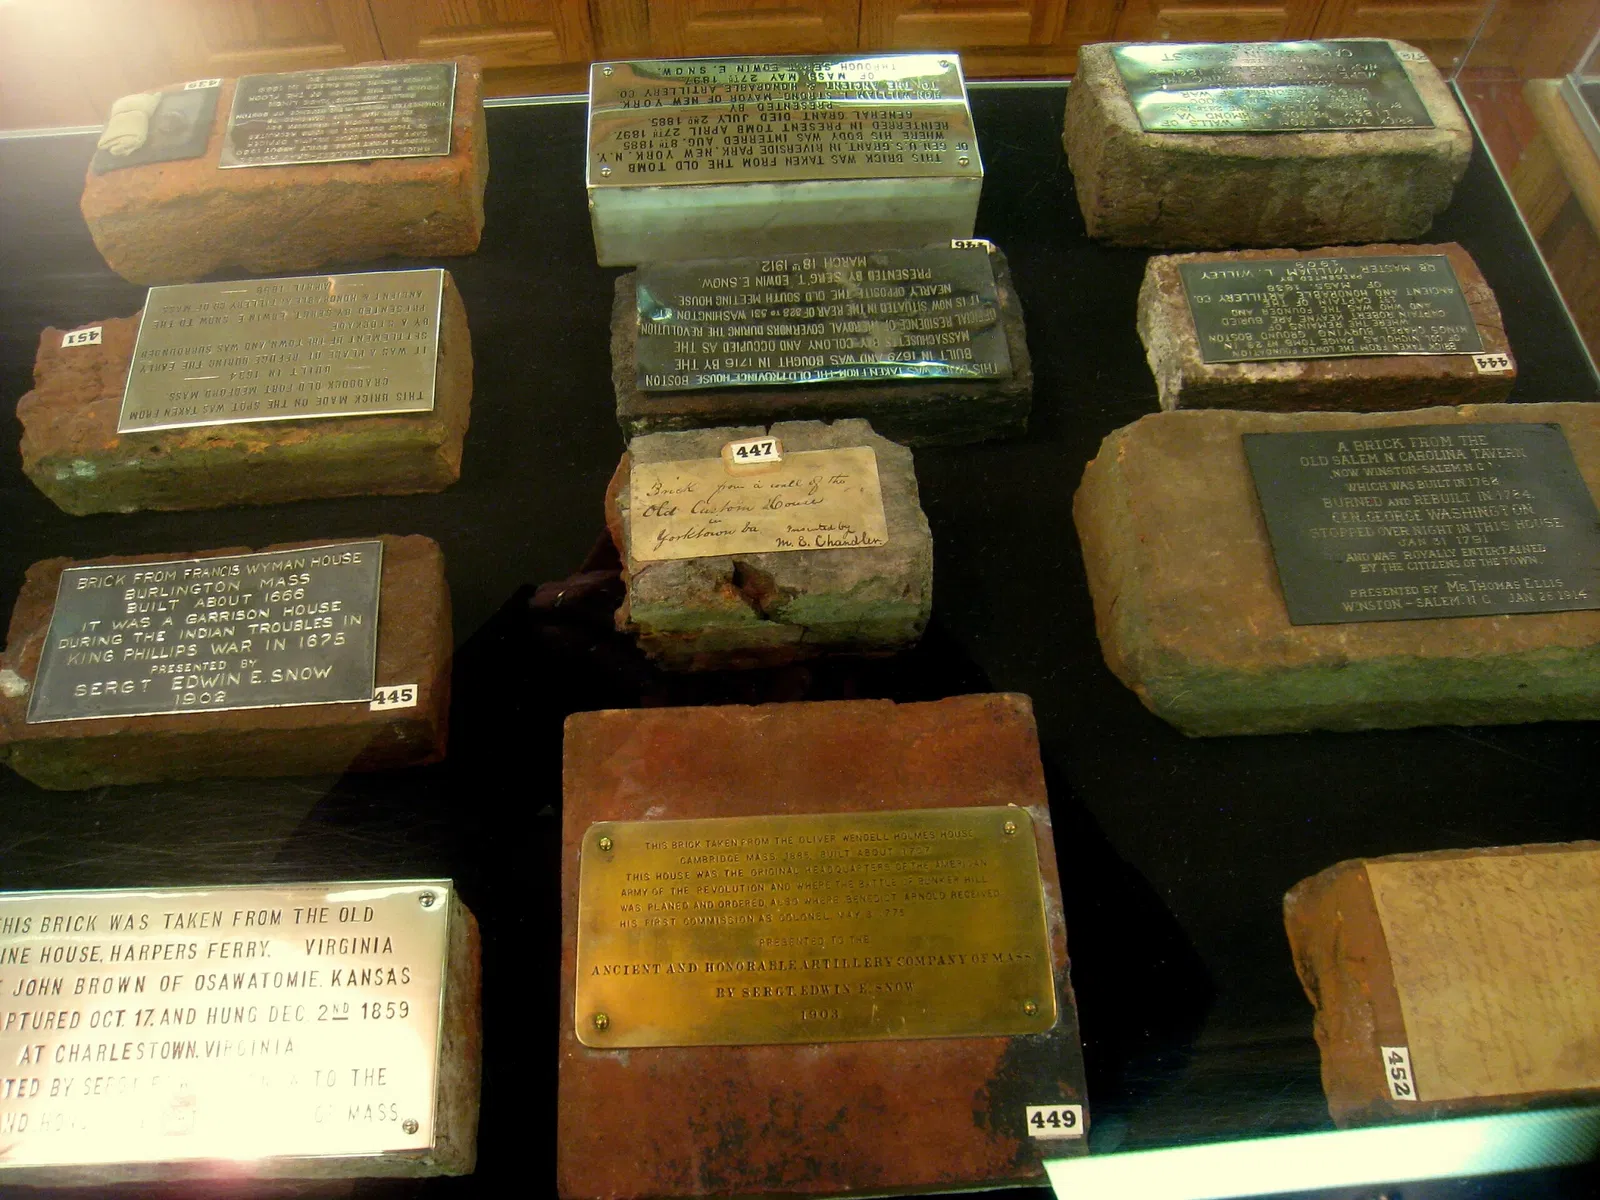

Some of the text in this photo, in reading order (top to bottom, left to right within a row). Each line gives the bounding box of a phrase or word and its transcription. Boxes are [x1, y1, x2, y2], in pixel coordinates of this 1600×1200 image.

[723, 133, 787, 144] INTERRED
[795, 132, 820, 141] WAS
[830, 131, 863, 141] BODY
[870, 131, 892, 141] HIS
[901, 130, 944, 141] WHERE
[622, 139, 653, 150] 1885
[627, 152, 942, 172] THIS BRICK WAS TAKEN FROM THE OLD TOMB
[754, 274, 789, 286] EDWIN
[847, 270, 863, 281] BY
[866, 267, 931, 281] PRESENTED
[1220, 309, 1446, 325] CAPTAIN ROBERT KEAYNE ARE BURIED
[68, 330, 99, 344] 451
[777, 354, 824, 367] BOUGHT
[829, 353, 855, 364] WAS
[859, 353, 883, 363] AND
[921, 350, 932, 360] IN
[939, 347, 972, 360] BUILT
[673, 357, 699, 371] THE
[702, 358, 720, 370] BY
[724, 356, 752, 367] 1716
[758, 356, 771, 367] IN
[1476, 357, 1508, 369] 444
[293, 397, 308, 407] ON
[395, 390, 423, 401] THIS
[163, 405, 197, 416] TAKEN
[201, 403, 225, 413] WAS
[266, 399, 287, 409] THE
[128, 409, 159, 419] FROM
[736, 442, 773, 458] 447
[1334, 434, 1489, 452] A BRICK FROM THE
[1298, 455, 1330, 467] OLD
[1331, 453, 1379, 465] SALEM
[1397, 448, 1467, 462] CAROLINA
[1471, 446, 1528, 460] TAVERN
[645, 475, 694, 497] Brick
[642, 500, 678, 518] Old
[689, 496, 754, 520] Custom
[655, 527, 737, 551] Yorktown
[76, 551, 362, 589] BRICK FROM FRANCIS WYMAN HOUSE
[124, 572, 310, 600] BURLINGTON MASS
[125, 587, 305, 614] BUILT ABOUT 1666
[81, 600, 341, 632] IT WAS A GARRISON HOUSE
[57, 613, 362, 650] DURING THE INDIAN TROUBLES IN
[66, 631, 345, 665] KING PHILLIPS WAR IN 1675
[150, 658, 256, 675] PRESENTED BY
[170, 671, 241, 691] EDWIN
[174, 689, 227, 706] 1902
[372, 689, 413, 705] 445
[0, 906, 374, 934] HIS BRICK WAS TAKEN FROM THE OLD
[109, 942, 197, 962] HARPERS
[305, 936, 393, 956] VIRGINIA
[592, 962, 661, 977] ANCIENT
[666, 962, 698, 974] AND
[705, 958, 797, 974] HONORABLE
[800, 955, 893, 971] ARTILLERY
[896, 953, 968, 967] COMPANY
[971, 952, 988, 963] OF
[12, 978, 63, 996] JOHN
[74, 975, 145, 995] BROWN
[159, 974, 183, 991] OF
[331, 966, 411, 987] KANSAS
[715, 987, 735, 998] BY
[800, 983, 850, 996] EDWIN
[159, 1007, 196, 1025] AND
[206, 1005, 257, 1024] HUNG
[317, 1002, 349, 1021] 2ND
[360, 1000, 409, 1020] 1859
[800, 1009, 838, 1020] 1903
[18, 1044, 44, 1064] AT
[1388, 1051, 1411, 1096] 452
[1030, 1109, 1076, 1129] 449
